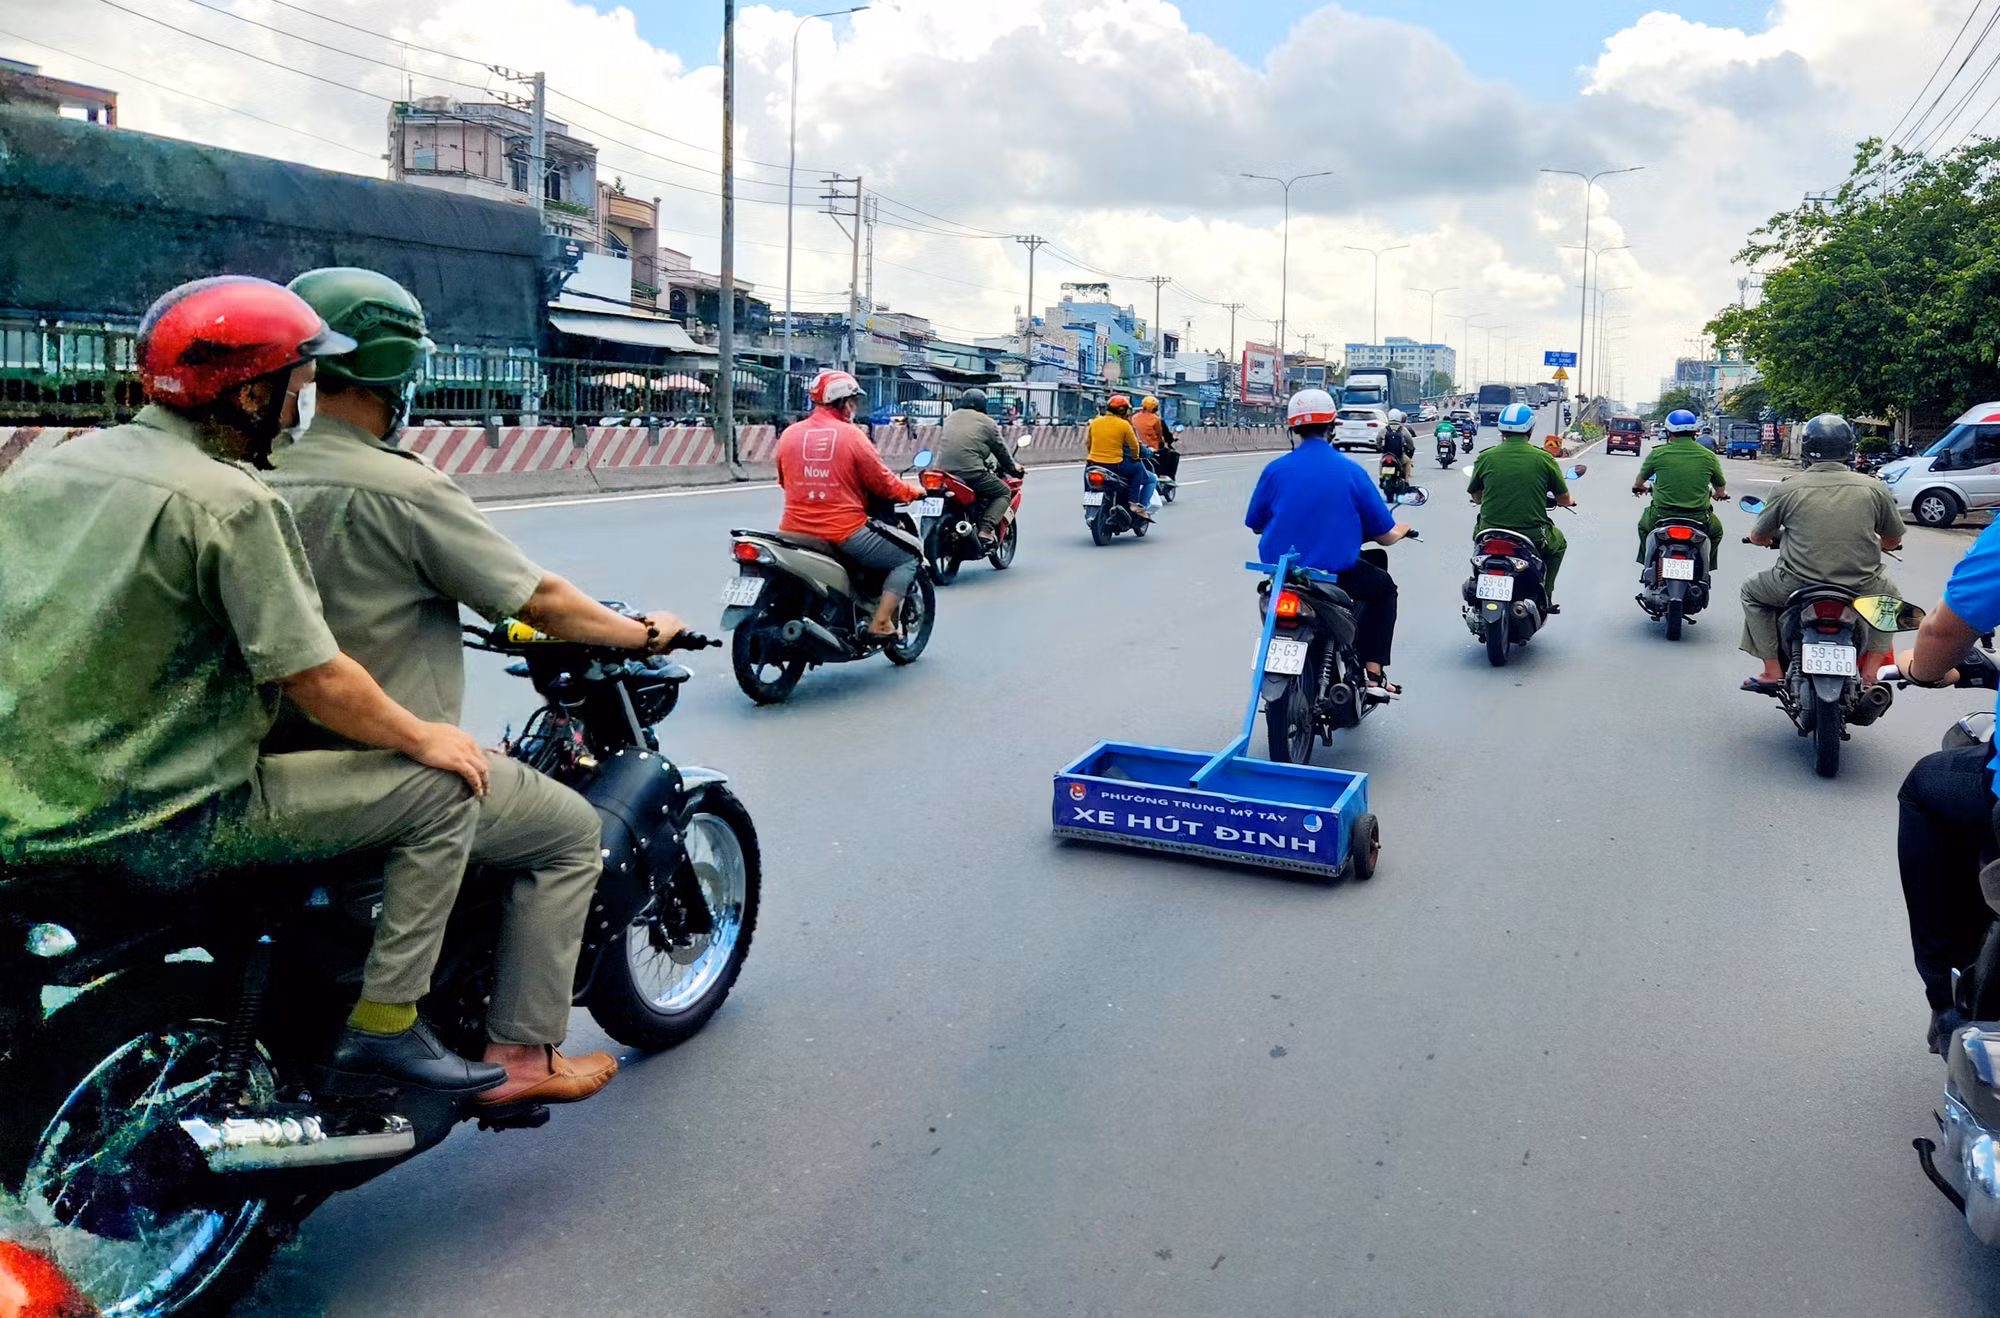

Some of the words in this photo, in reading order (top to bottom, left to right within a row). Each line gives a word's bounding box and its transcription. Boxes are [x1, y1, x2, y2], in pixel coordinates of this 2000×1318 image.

[804, 466, 830, 478] Now
[1668, 560, 1690, 570] 59-G3
[1483, 576, 1507, 588] 59-G1
[1478, 587, 1510, 599] 621.99
[1270, 642, 1299, 656] 9-G3
[1811, 646, 1846, 660] 59-G1
[1806, 659, 1852, 673] 893.60
[1101, 792, 1168, 806] PHƯỜNG
[1172, 800, 1225, 813] TRUNG
[1230, 808, 1254, 818] MỸ
[1257, 812, 1287, 822] TÂY
[1072, 806, 1115, 825] XE
[1127, 813, 1203, 836] HÚT
[1213, 825, 1316, 853] ĐINH
